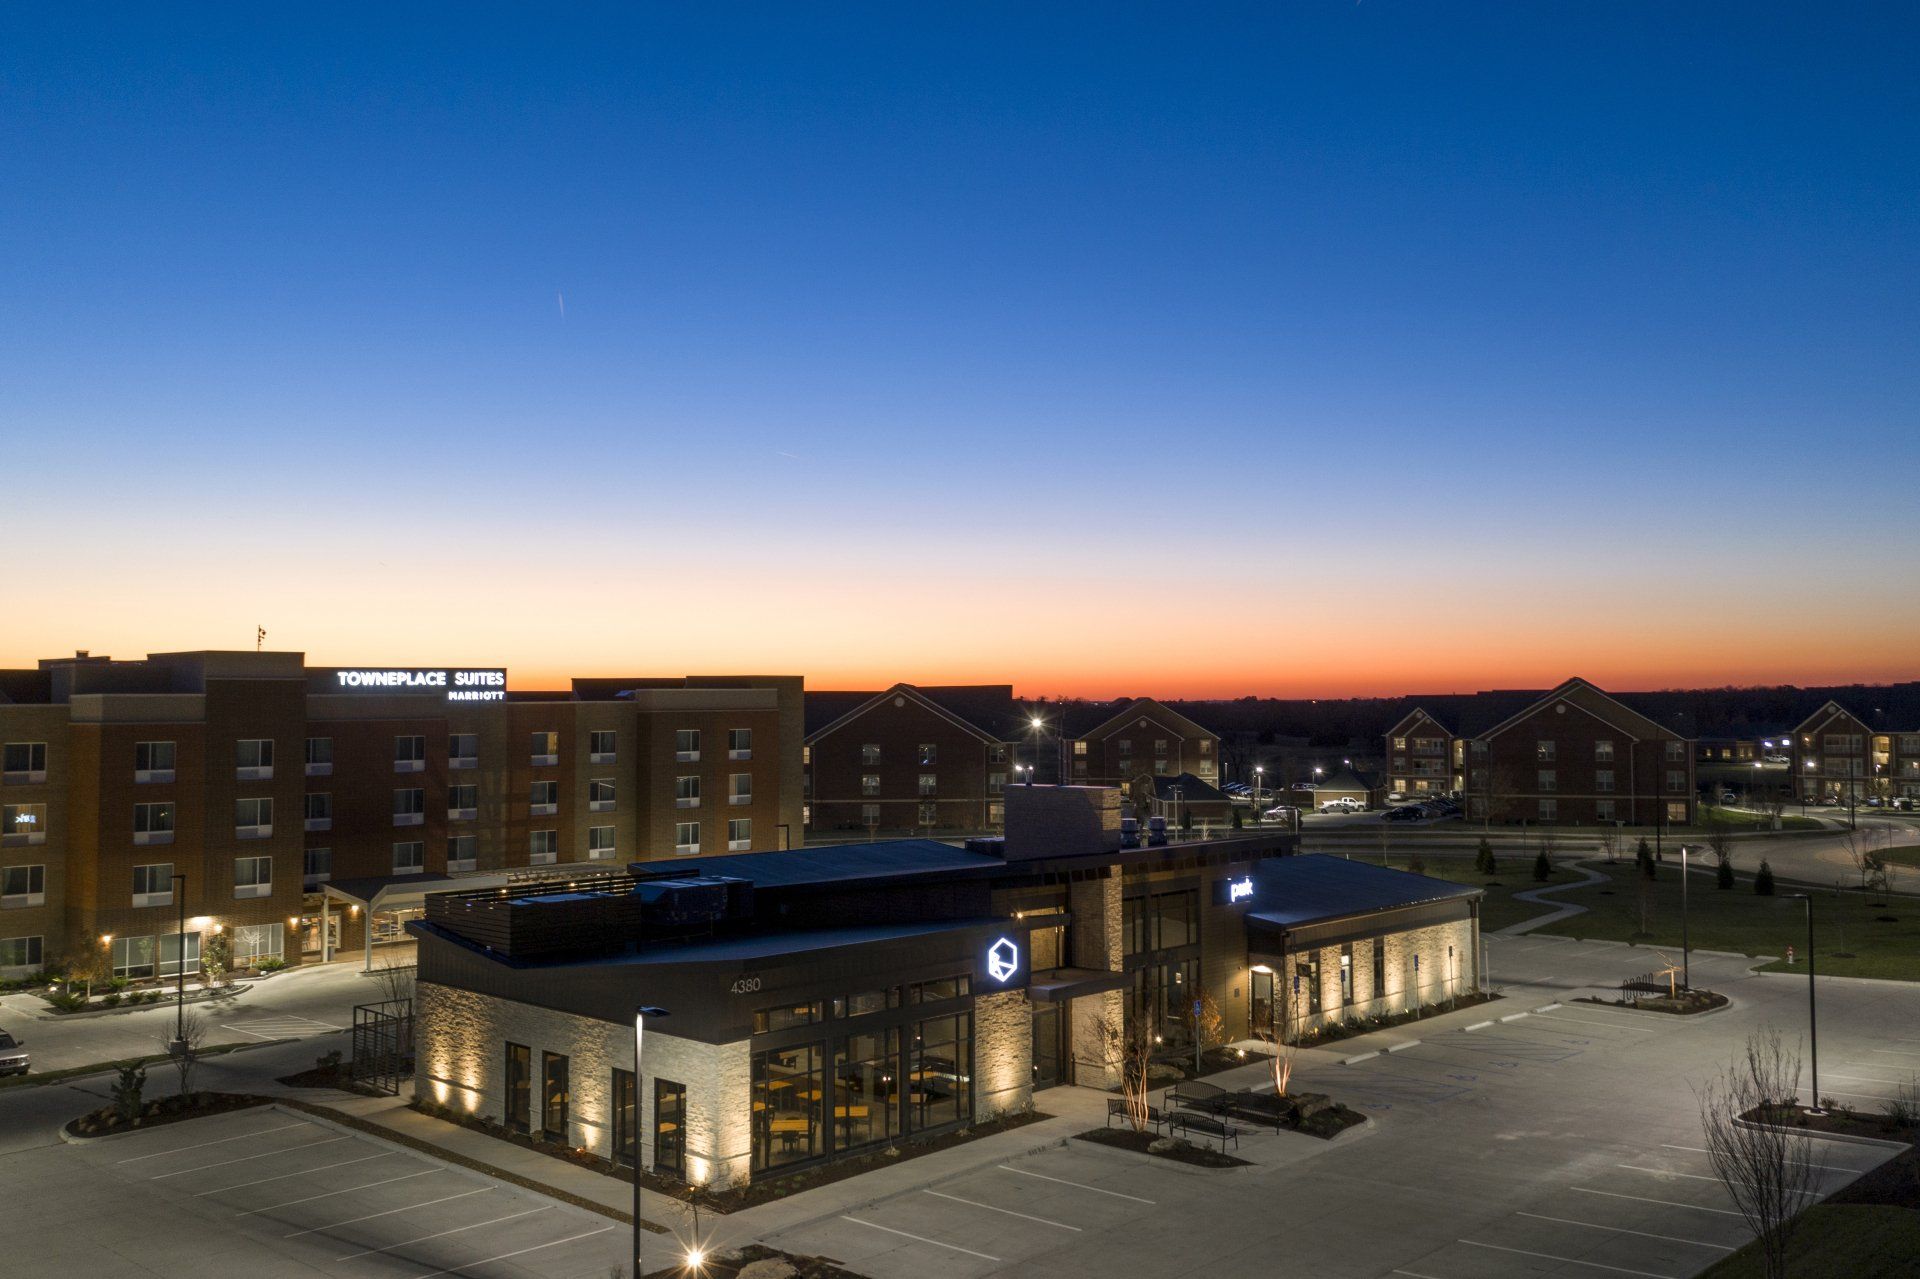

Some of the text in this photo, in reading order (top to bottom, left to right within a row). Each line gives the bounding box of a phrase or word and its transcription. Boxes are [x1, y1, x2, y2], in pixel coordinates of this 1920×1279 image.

[337, 671, 504, 686] TOWNEPLACE SUITES
[448, 691, 505, 701] MARRIOTT
[731, 977, 761, 994] 4380
